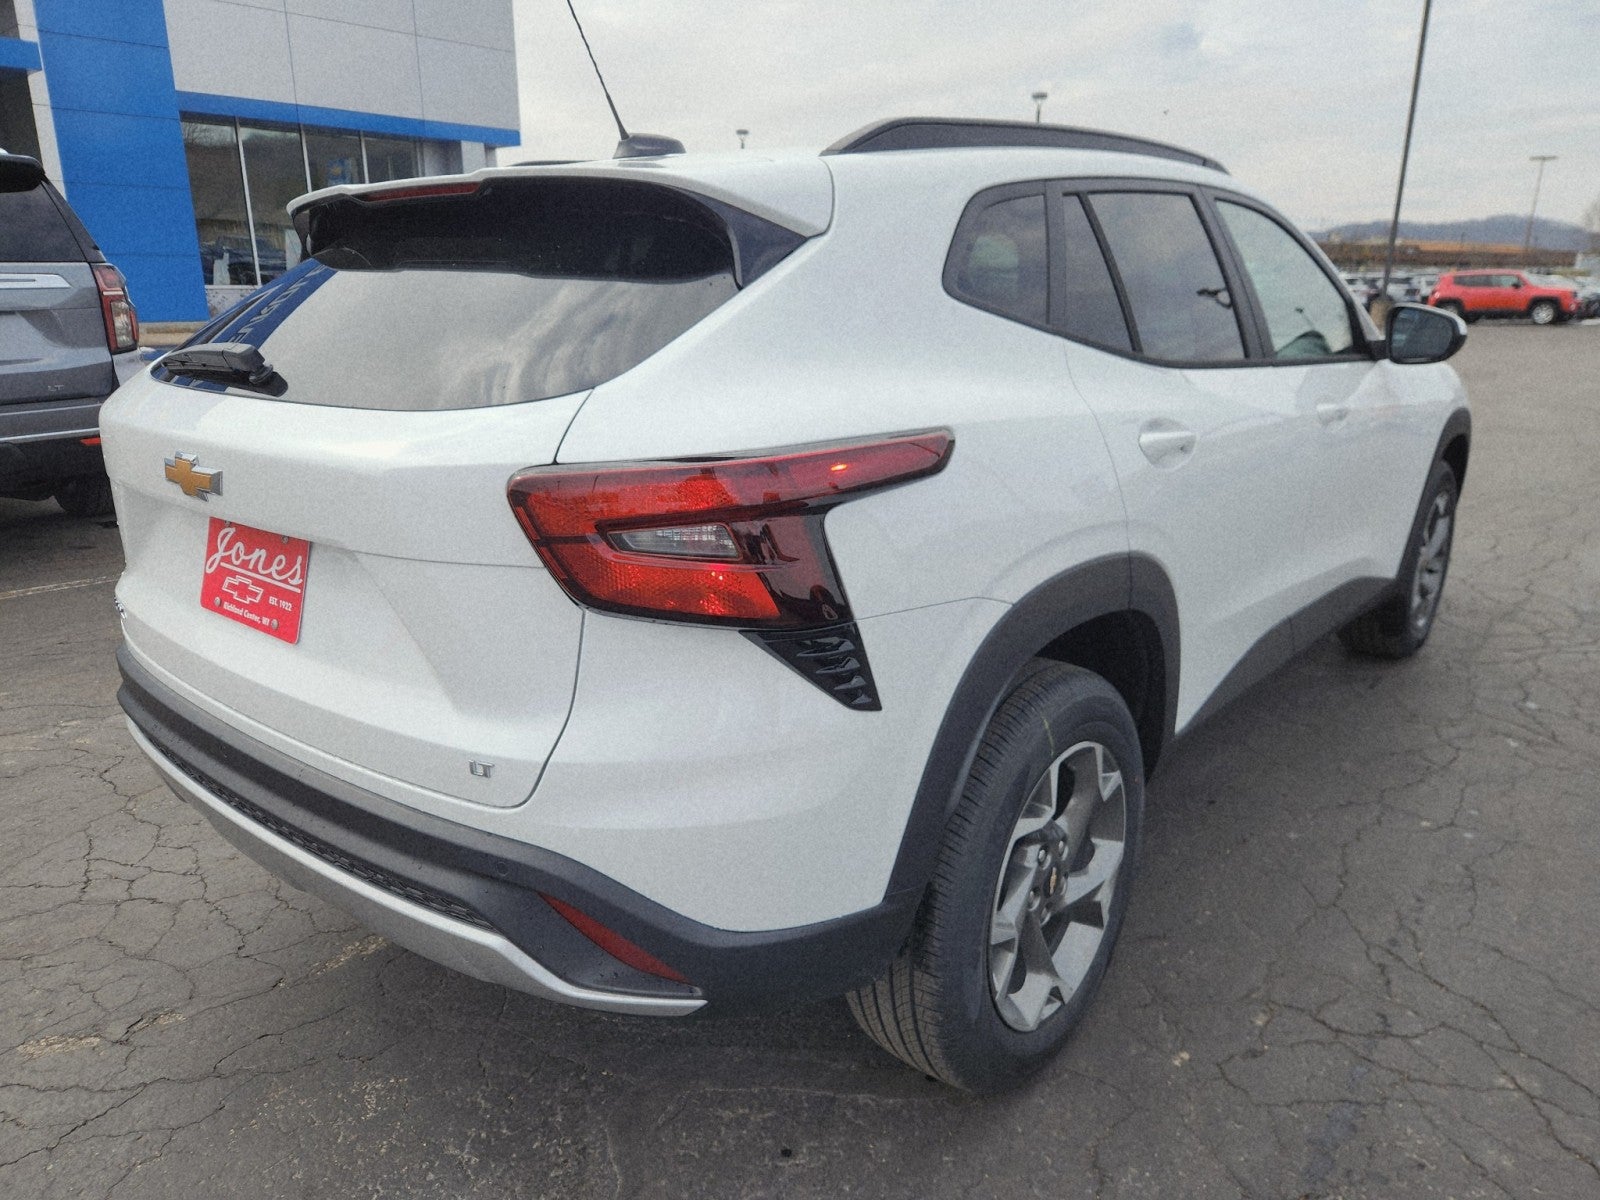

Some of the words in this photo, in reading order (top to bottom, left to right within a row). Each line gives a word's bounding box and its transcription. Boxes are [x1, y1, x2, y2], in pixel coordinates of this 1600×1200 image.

[205, 527, 303, 585] Jones
[268, 596, 278, 607] EST.
[279, 600, 292, 612] 1922
[468, 759, 495, 778] LT
